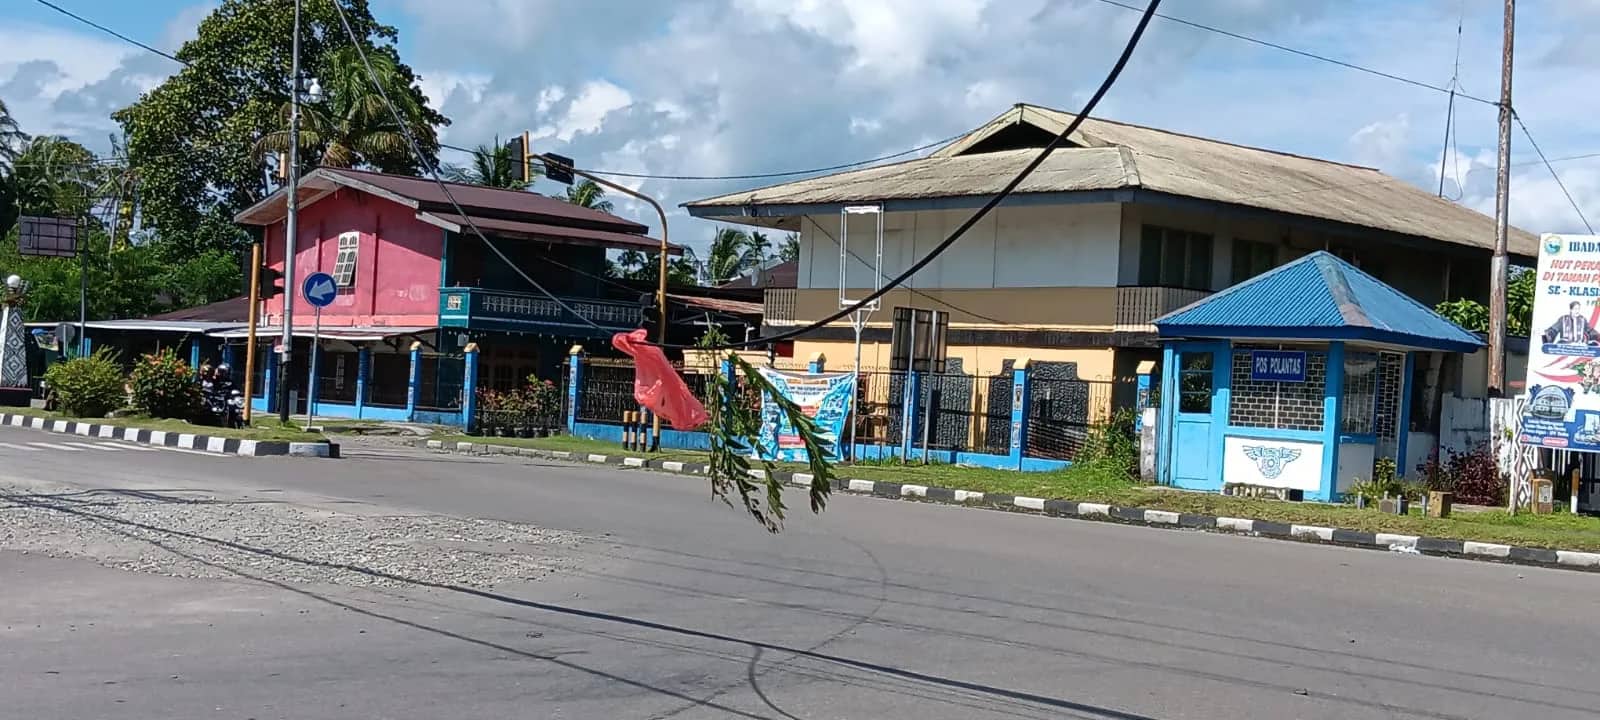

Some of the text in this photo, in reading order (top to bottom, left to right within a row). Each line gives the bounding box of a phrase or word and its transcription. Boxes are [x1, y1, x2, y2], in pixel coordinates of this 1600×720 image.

[1550, 259, 1573, 269] HUT
[1542, 271, 1600, 284] DI TANAH P
[1547, 285, 1561, 295] SE
[1256, 356, 1301, 375] POS POLANTAS
